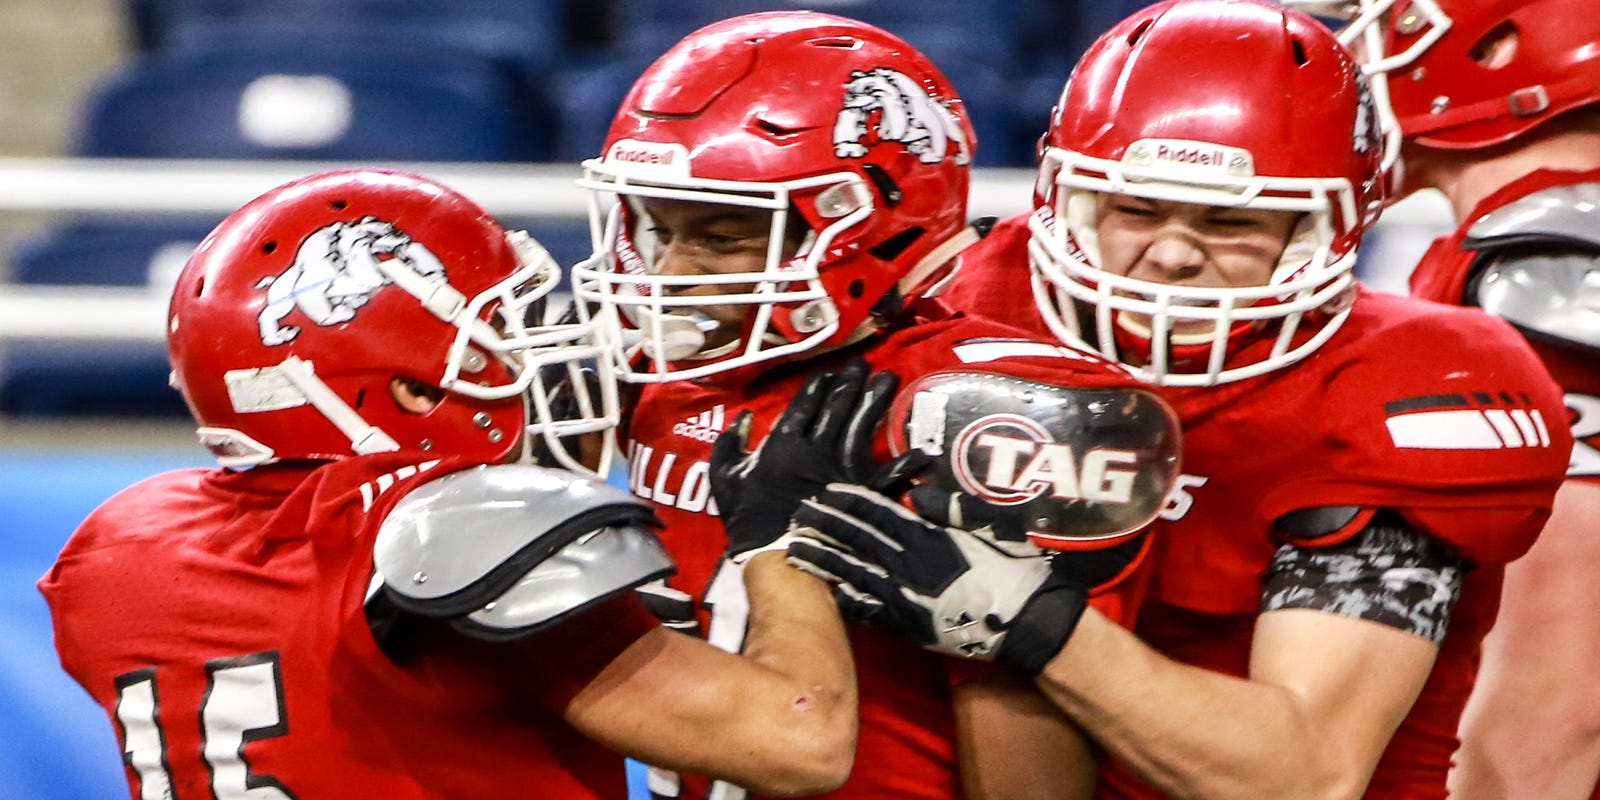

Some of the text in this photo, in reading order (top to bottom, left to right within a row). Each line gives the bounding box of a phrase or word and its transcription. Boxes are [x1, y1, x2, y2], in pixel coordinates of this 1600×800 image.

[1157, 144, 1225, 167] Riddell
[672, 422, 721, 444] adida
[974, 431, 1139, 505] TAG
